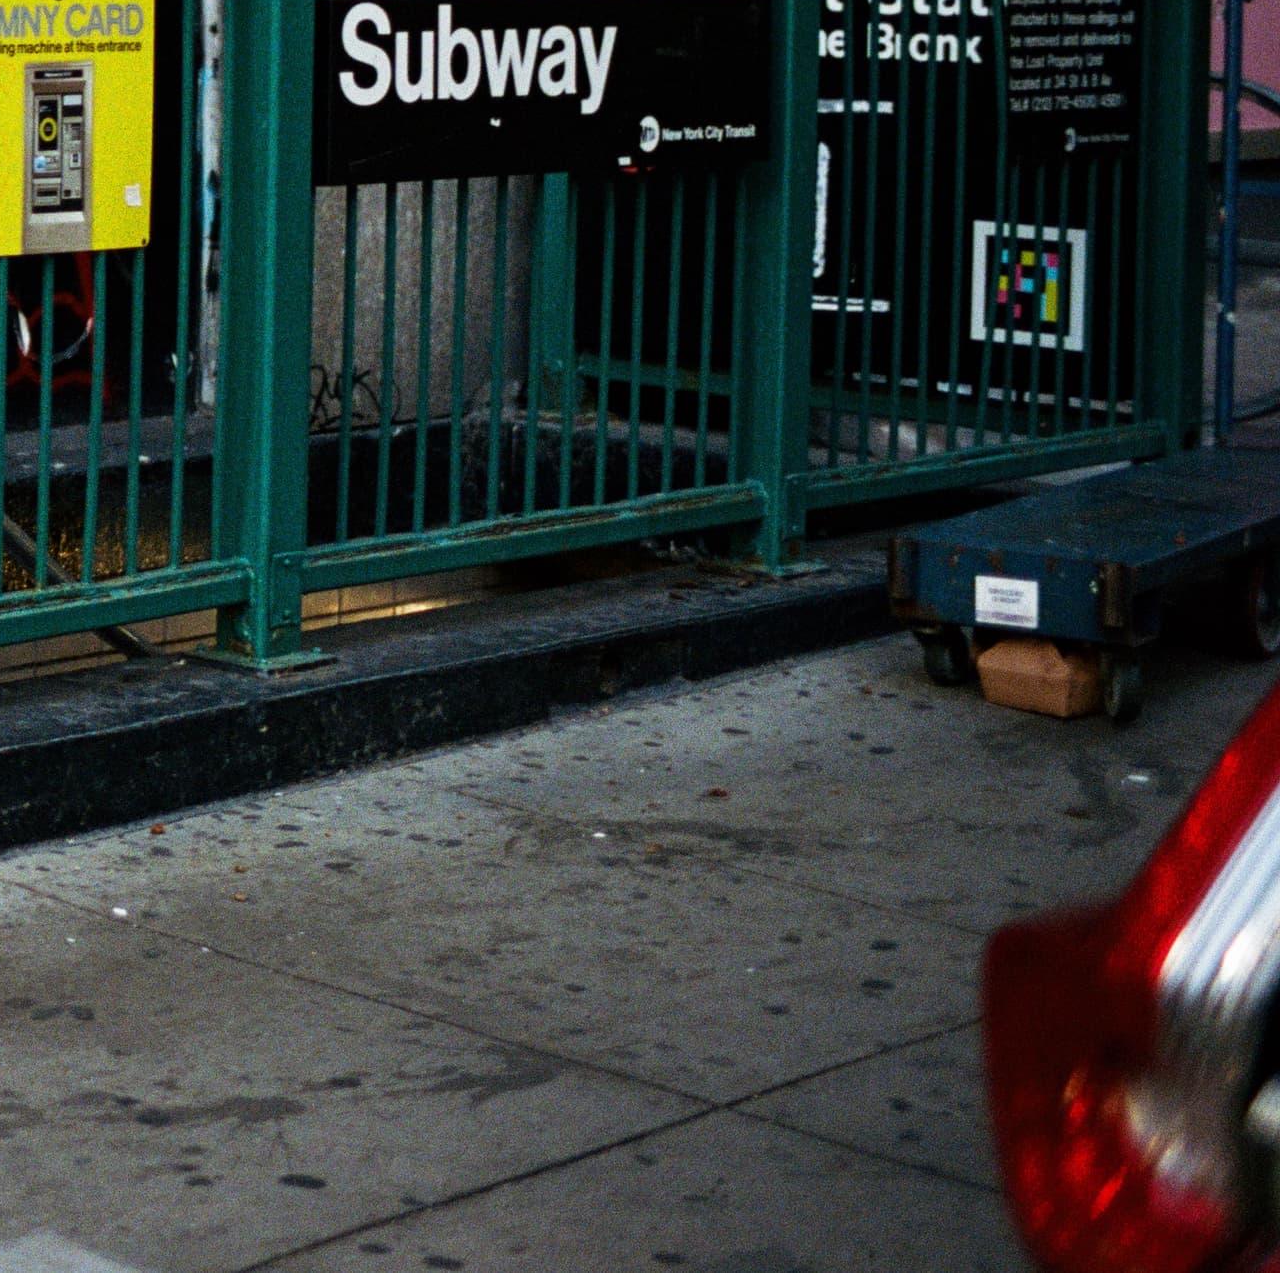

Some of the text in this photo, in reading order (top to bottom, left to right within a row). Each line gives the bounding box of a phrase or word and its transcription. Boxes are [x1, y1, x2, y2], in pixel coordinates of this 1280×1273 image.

[64, 3, 144, 37] CARD
[17, 40, 62, 54] machine
[64, 41, 74, 53] at
[75, 40, 95, 53] this
[96, 40, 142, 52] entrance
[339, 2, 617, 115] Subway
[662, 128, 682, 141] New
[683, 127, 704, 140] York
[705, 126, 724, 142] City
[724, 124, 756, 138] Transit
